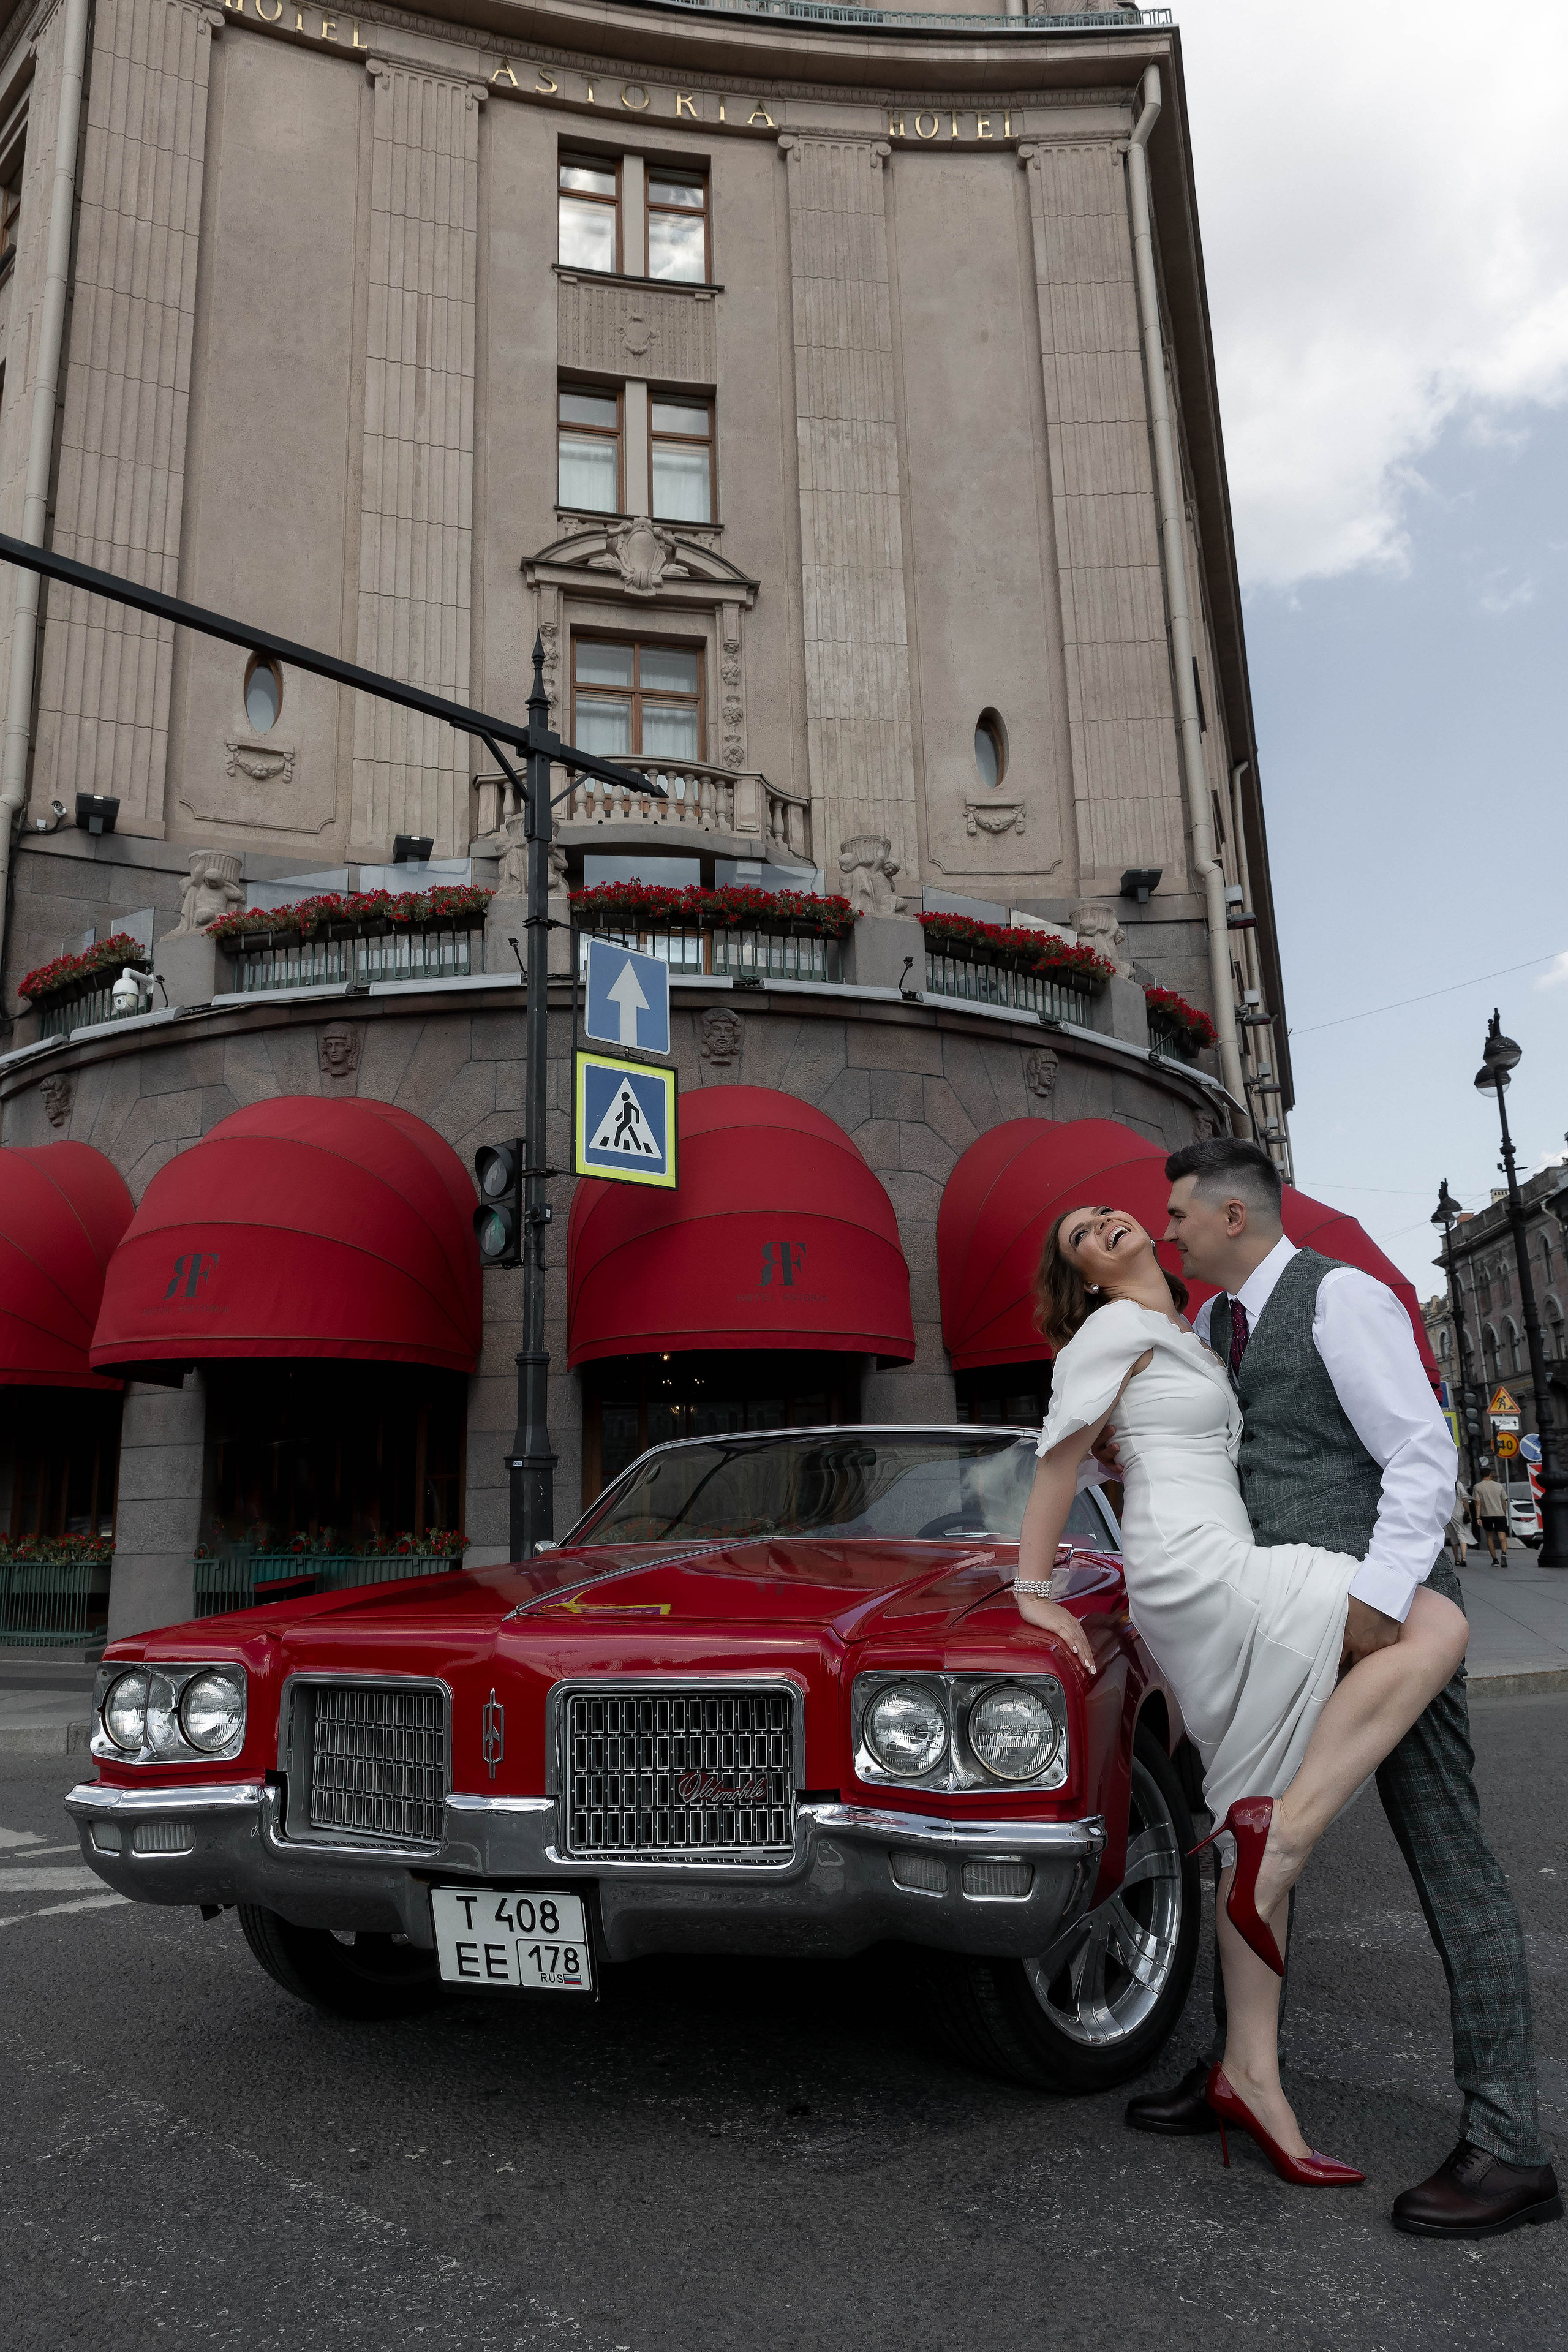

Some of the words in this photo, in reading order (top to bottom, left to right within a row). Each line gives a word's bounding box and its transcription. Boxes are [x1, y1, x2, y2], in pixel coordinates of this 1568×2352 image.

[490, 56, 775, 126] ASTORIA
[889, 110, 1019, 138] HOTEL
[737, 1293, 774, 1302] HOTEL
[783, 1293, 828, 1302] ASTORIA
[678, 1773, 766, 1803] Oldsmobile
[456, 1895, 478, 1930] T
[495, 1898, 560, 1934] 408
[456, 1942, 509, 1980] EE
[528, 1945, 580, 1973] 178
[541, 1973, 564, 1984] RUS
